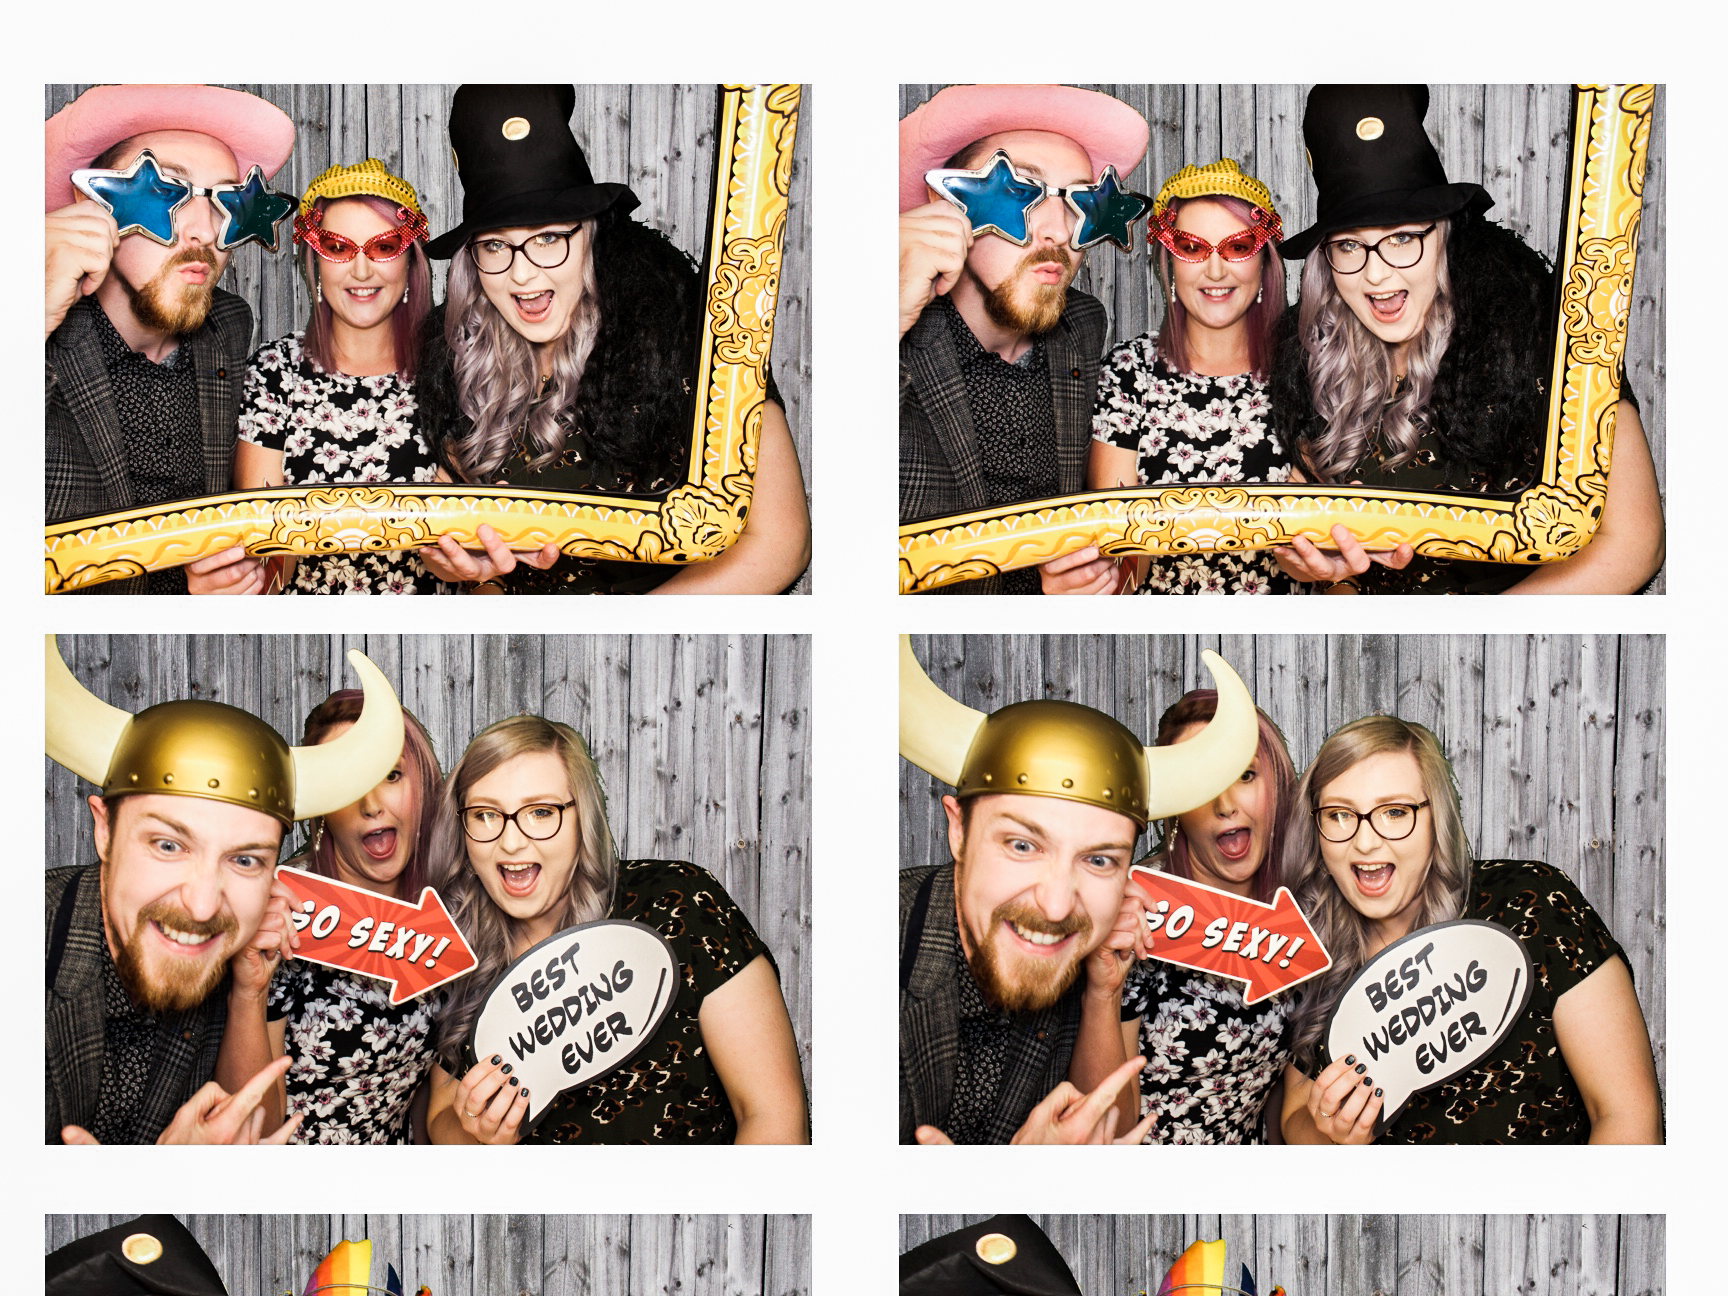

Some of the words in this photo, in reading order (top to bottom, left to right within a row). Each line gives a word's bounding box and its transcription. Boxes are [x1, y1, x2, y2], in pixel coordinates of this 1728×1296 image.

[348, 916, 453, 969] SEXY!
[1202, 916, 1307, 969] SEXY!
[508, 959, 634, 1062] WEDDING
[511, 942, 580, 1013] BEST
[1362, 959, 1488, 1062] WEDDING
[1365, 942, 1434, 1013] BEST
[561, 1011, 633, 1075] EVER
[1415, 1011, 1487, 1075] EVER
